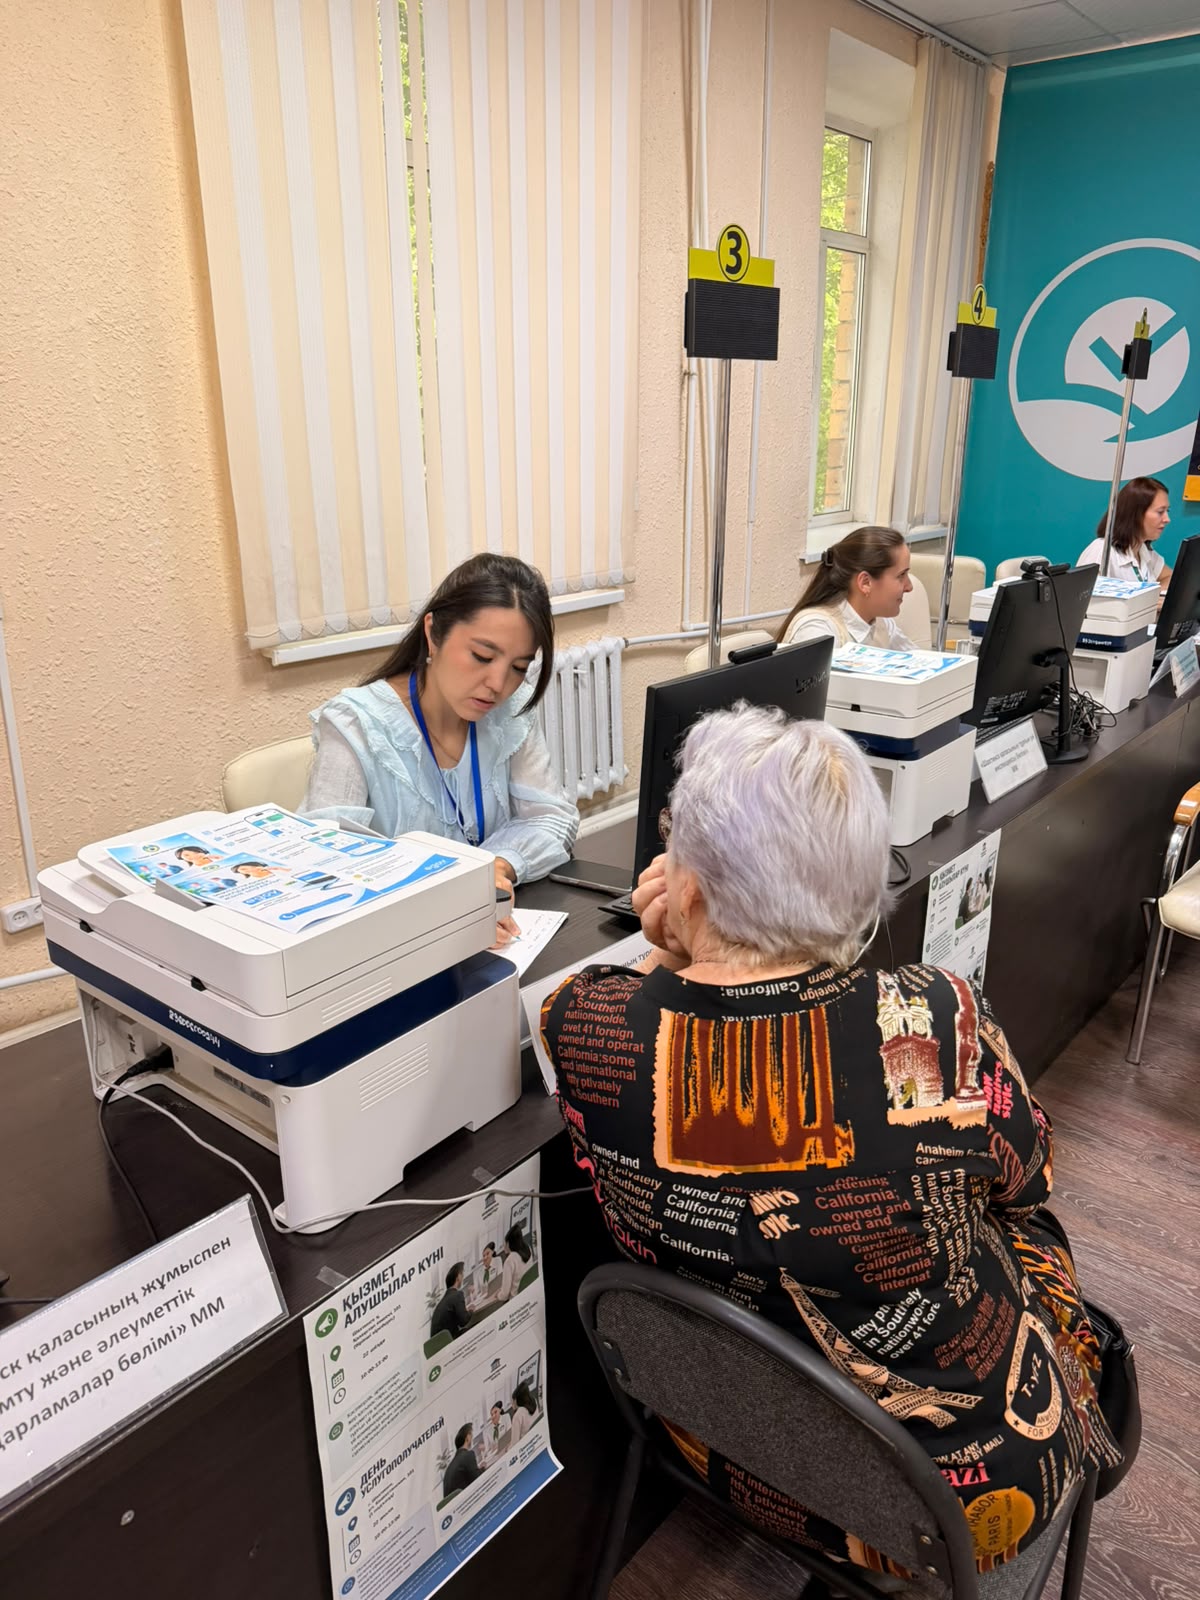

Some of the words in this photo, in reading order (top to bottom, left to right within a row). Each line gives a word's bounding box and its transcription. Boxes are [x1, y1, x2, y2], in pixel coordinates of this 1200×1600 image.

[725, 231, 743, 275] 3
[973, 290, 983, 319] 4
[576, 997, 626, 1013] Southern
[582, 1024, 593, 1034] 41
[595, 1025, 634, 1040] foreign
[558, 1035, 585, 1045] owned
[586, 1037, 605, 1048] and
[607, 1040, 645, 1053] operat
[560, 1061, 574, 1070] and
[576, 1088, 620, 1108] Southern
[592, 1143, 618, 1161] owned
[620, 1154, 640, 1170] and
[916, 1142, 964, 1157] Anaheim
[608, 1171, 654, 1200] Southern
[940, 1170, 951, 1183] in
[672, 1184, 720, 1202] owned
[911, 1174, 925, 1202] over
[663, 1208, 687, 1223] and
[831, 1205, 882, 1222] owned
[885, 1200, 912, 1215] and
[809, 1219, 862, 1236] owned
[866, 1214, 892, 1229] and
[342, 1263, 396, 1312] ҚЫЗМЕТ
[344, 1267, 416, 1328] АЛУШЫЛАР
[417, 1246, 444, 1274] КҮНІ
[879, 1270, 931, 1292] internat
[27, 1290, 138, 1365] қаласының
[141, 1236, 231, 1297] жұмыспен
[41, 1349, 95, 1389] және
[97, 1287, 196, 1357] әлеуметтік
[117, 1323, 187, 1373] бөлімі»
[190, 1296, 226, 1329] ММ
[863, 1337, 880, 1349] in
[890, 1339, 915, 1359] over
[912, 1326, 927, 1339] 41
[1027, 1426, 1044, 1438] FOR
[360, 1416, 445, 1499] УСЛУГОПОЛУЧАТЕЛЕЙ
[950, 1449, 962, 1461] AT
[963, 1440, 980, 1453] ANY
[957, 1455, 971, 1465] OR
[972, 1449, 983, 1460] BY
[360, 1457, 387, 1489] ДЕНЬ
[724, 1461, 745, 1480] and
[988, 1515, 1001, 1546] PARIS
